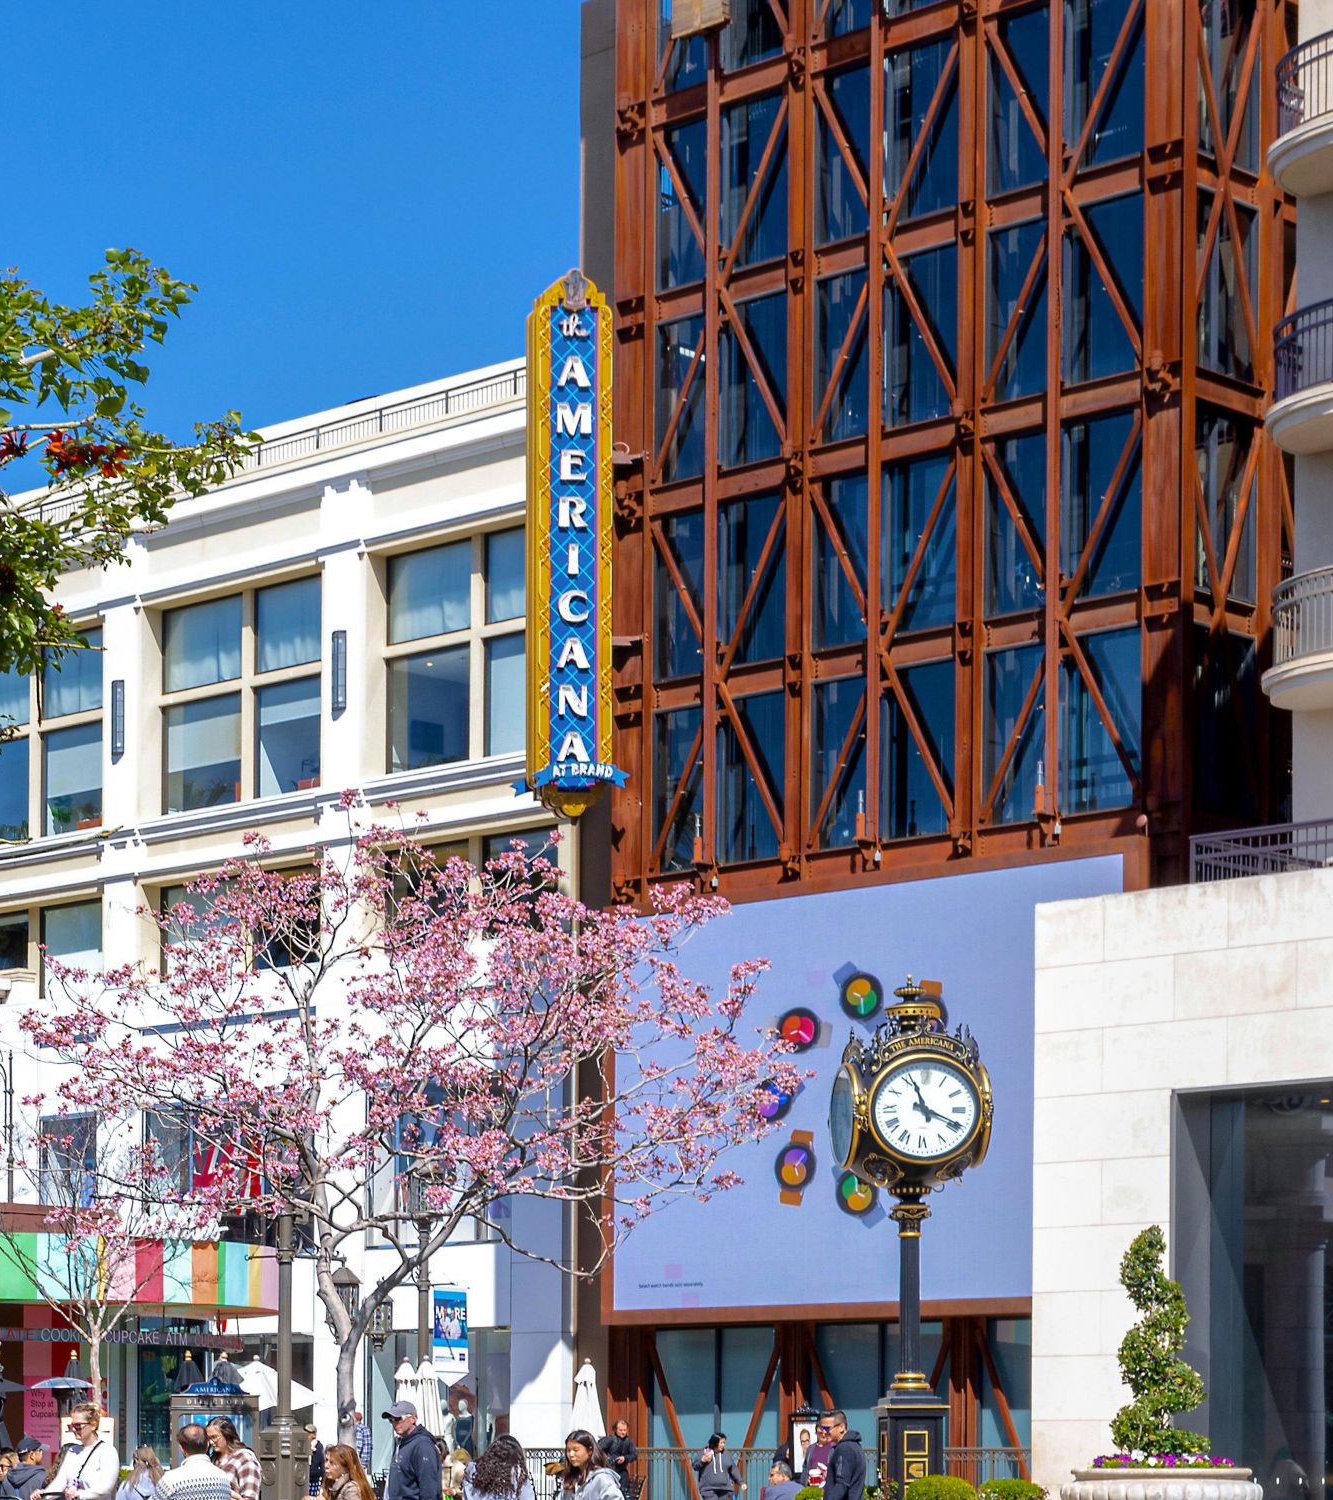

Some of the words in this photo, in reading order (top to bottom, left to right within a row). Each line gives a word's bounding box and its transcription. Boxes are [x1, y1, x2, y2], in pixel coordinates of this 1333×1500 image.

[556, 355, 592, 762] AMERICANA
[552, 764, 567, 777] AT
[571, 763, 614, 778] BRAND
[890, 1040, 906, 1052] THE
[908, 1037, 954, 1051] AMERICANA
[105, 1330, 160, 1344] CUPCAKE
[166, 1333, 188, 1346] ATM
[30, 1400, 46, 1409] Stop
